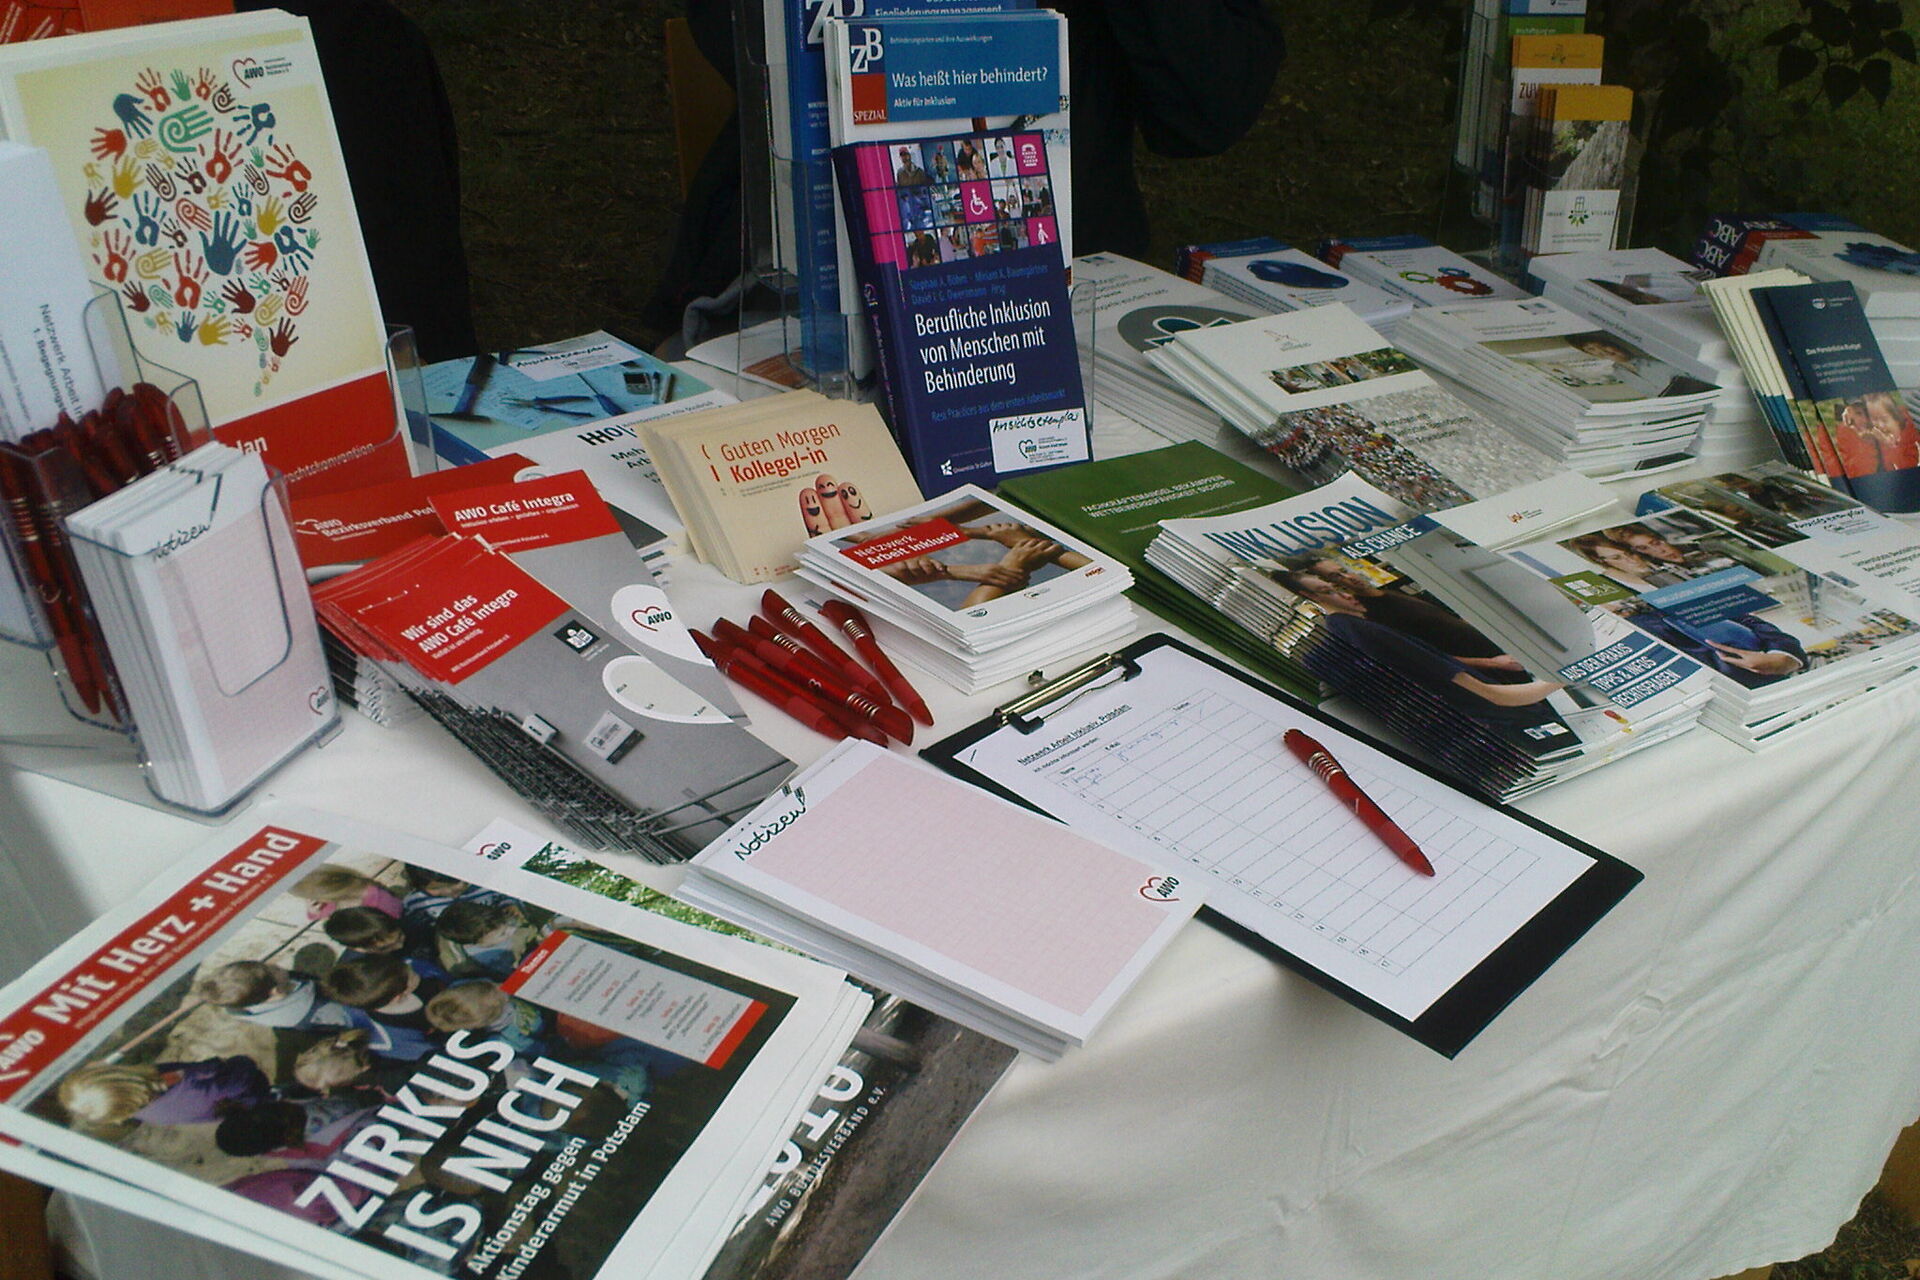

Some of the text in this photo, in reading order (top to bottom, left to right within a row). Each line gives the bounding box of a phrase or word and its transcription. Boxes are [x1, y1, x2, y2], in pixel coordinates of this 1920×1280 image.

[244, 66, 264, 79] AWO
[892, 66, 1048, 88] Was heißt hier behindert?
[854, 109, 887, 122] SPEZIAL
[893, 96, 957, 107] Aktiv für Inklusion
[1711, 219, 1744, 247] ABC
[1697, 240, 1731, 268] ABC
[915, 299, 1051, 336] Berufliche Inklusion
[39, 303, 67, 364] Netzwerk
[60, 367, 80, 404] Arbeit
[920, 326, 1046, 365] von Menschen mit
[924, 361, 1016, 394] Behinderung
[611, 447, 646, 461] Meh
[720, 423, 841, 462] Guten Morgen
[626, 457, 652, 469] Arb
[321, 510, 413, 537] Bezirksverband
[412, 505, 436, 518] Pot
[454, 492, 575, 522] AWO Café Integra
[853, 534, 917, 558] Netzwerk
[1202, 496, 1398, 561] INKLUSION
[1342, 523, 1423, 560] ALS CHANCE
[867, 531, 960, 565] Arbeit Inklusiv
[400, 594, 478, 641] Wir sind das
[417, 588, 519, 653] AWO Café Integra
[646, 611, 673, 626] AWO
[1561, 643, 1633, 682] AUS DER PRAXIS
[1591, 671, 1624, 692] TIPPS
[1627, 655, 1658, 676] INFOS
[1611, 668, 1683, 708] RECHTSFRAGEN
[1017, 747, 1051, 765] Netzwerk
[1050, 734, 1072, 749] Arbeit
[1098, 704, 1132, 722] Potsdam
[734, 803, 805, 861] Notizen
[487, 842, 512, 861] AWO
[1157, 876, 1180, 898] AWO
[32, 831, 300, 1024] Mit Herz + Hand
[520, 948, 550, 974] Themen
[0, 1029, 45, 1072] AWO
[294, 1029, 516, 1231] ZIRKUS
[383, 1190, 483, 1262] IS
[440, 1056, 600, 1194] NICH
[765, 1085, 887, 1228] AWO BUNDESVERBAND e.V.
[466, 1135, 587, 1276] Aktionstag gegen
[495, 1100, 652, 1280] Kinderarmut in Potsdam
